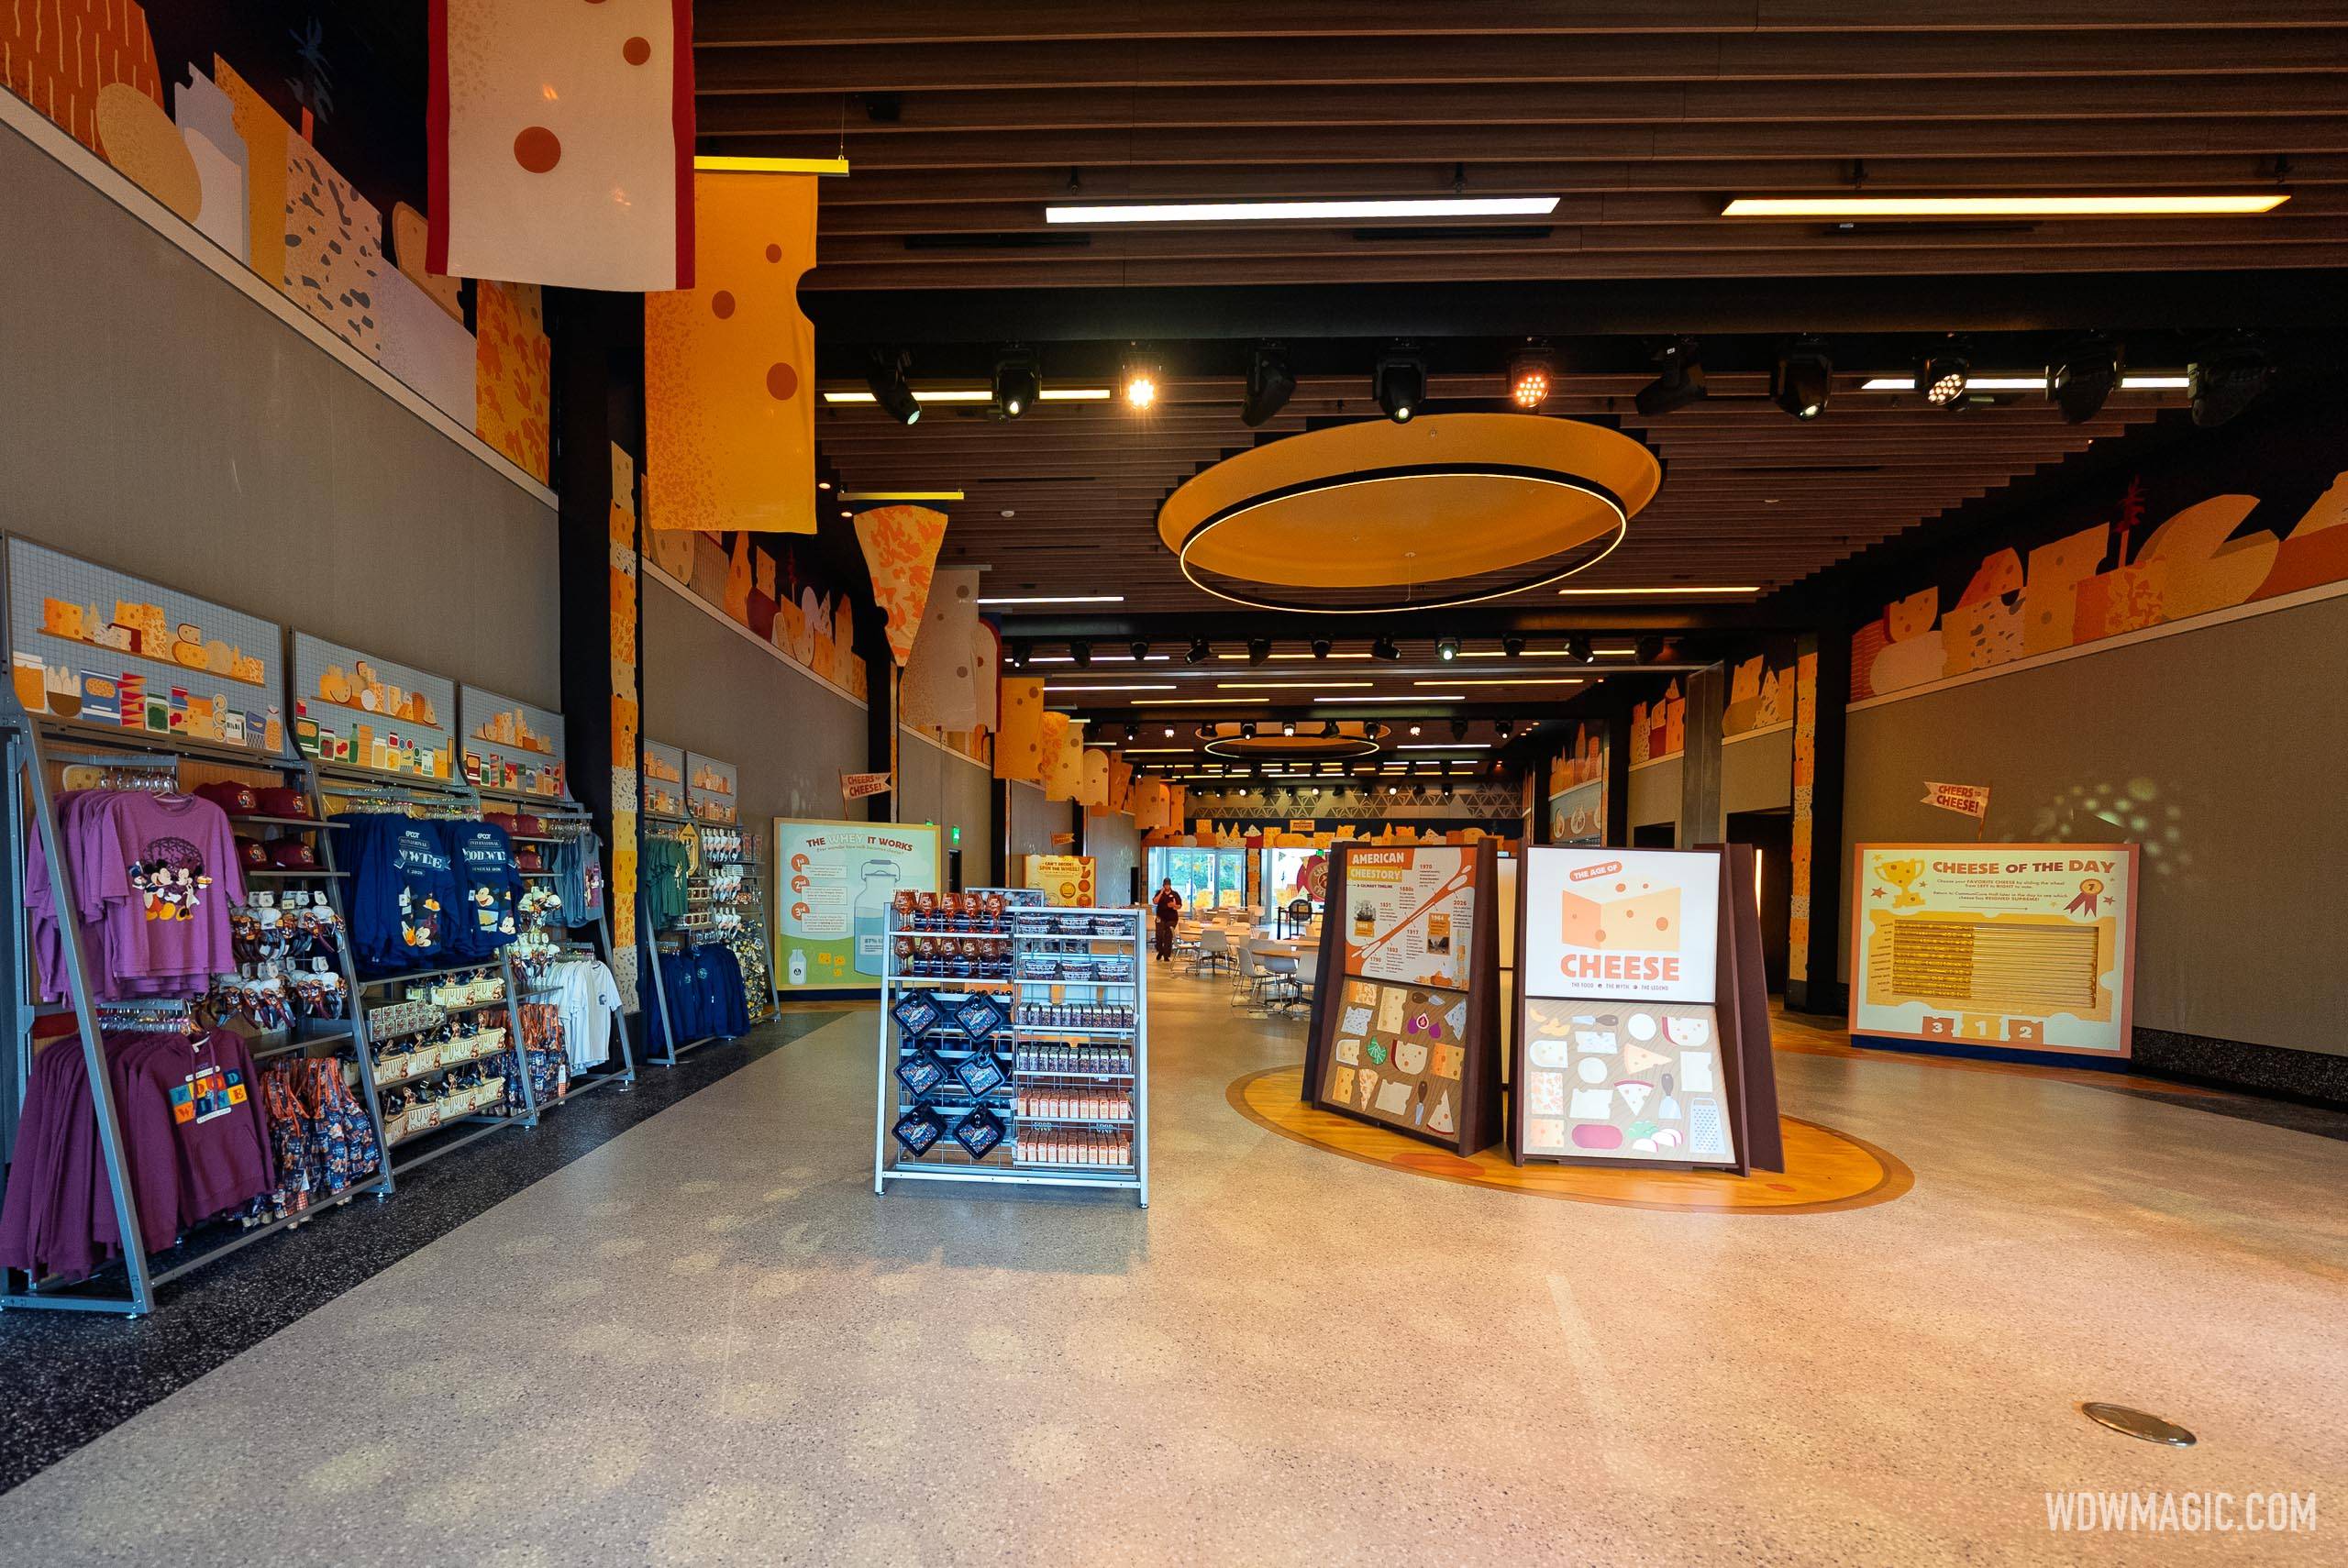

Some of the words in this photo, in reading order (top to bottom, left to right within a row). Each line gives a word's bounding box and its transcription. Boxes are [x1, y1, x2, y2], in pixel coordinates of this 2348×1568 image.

[847, 776, 874, 785] CHEERS
[849, 783, 881, 797] CHEESE!
[1938, 785, 1974, 798] CHEERS
[1937, 795, 1979, 813] CHEESE!
[806, 837, 825, 847] THE
[828, 833, 864, 844] WHEY
[879, 837, 914, 852] WORKS
[1352, 853, 1404, 864] AMERICAN
[1574, 871, 1589, 879] THE
[1590, 867, 1607, 876] AGE
[1607, 864, 1618, 872] OF
[1933, 862, 1999, 874] CHEESE
[2005, 864, 2027, 873] OF
[2032, 862, 2064, 872] THE
[2068, 860, 2115, 873] DAY
[1561, 954, 1679, 981] CHEESE
[1932, 1022, 1943, 1033] 3
[1975, 1021, 1987, 1036] 1
[2020, 1026, 2032, 1038] 2
